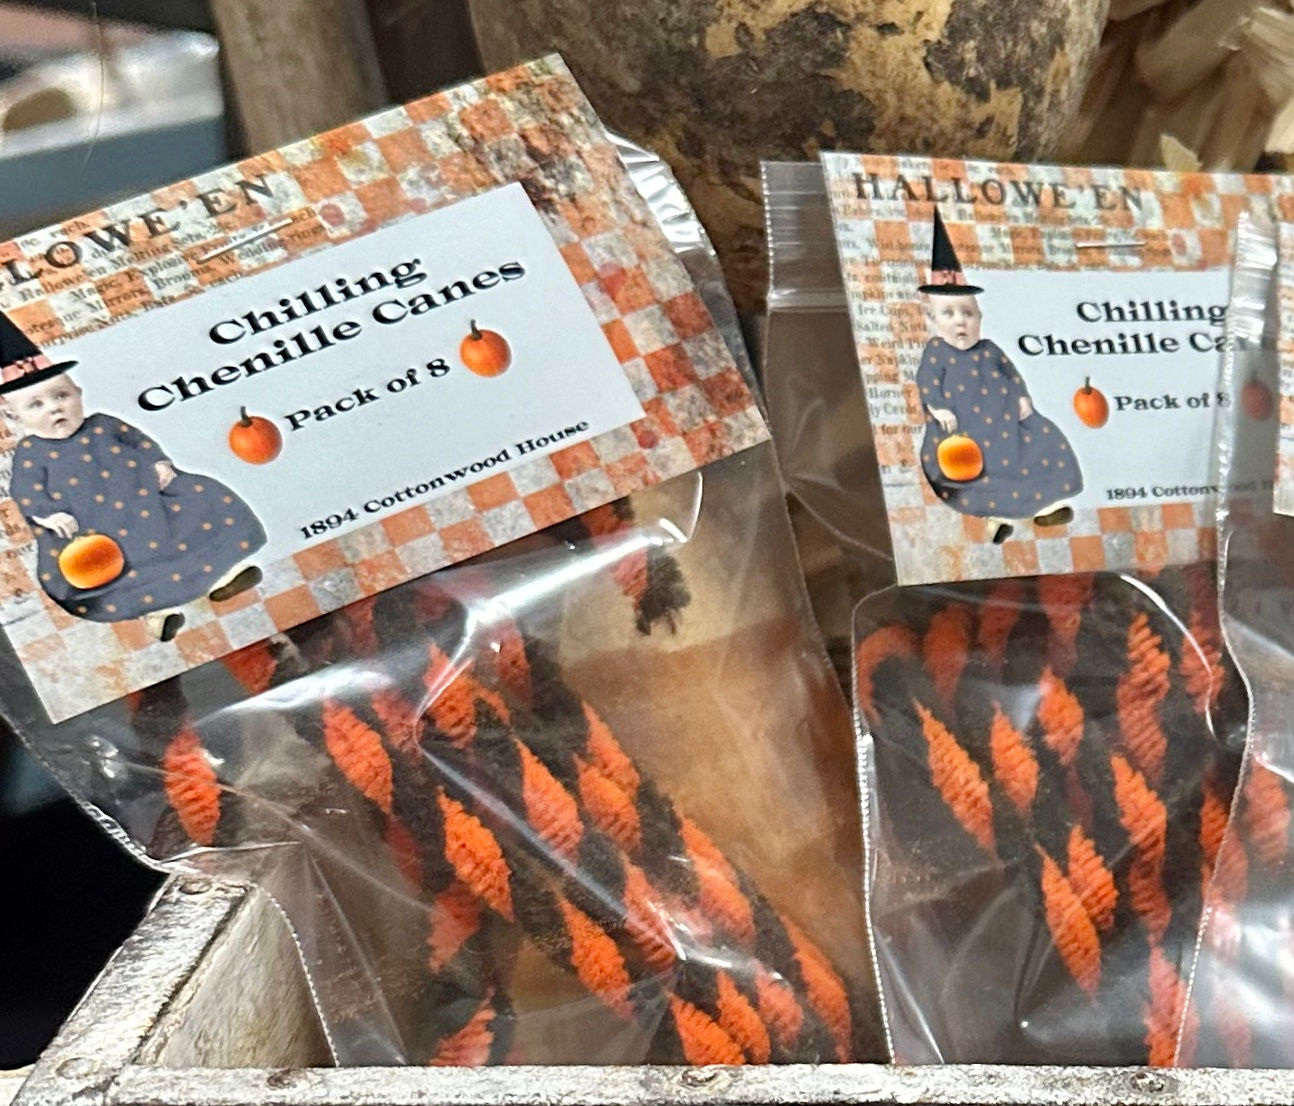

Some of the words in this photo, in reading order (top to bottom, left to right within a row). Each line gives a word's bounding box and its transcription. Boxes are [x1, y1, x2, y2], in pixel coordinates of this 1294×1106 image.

[853, 171, 1146, 212] HALLOWE'EN
[0, 174, 274, 288] LOWE'EN
[209, 257, 428, 345] Chilling
[1077, 299, 1228, 327] Chilling
[138, 320, 362, 412] Chenille
[372, 261, 526, 325] Canes
[1018, 331, 1180, 357] Chenille
[284, 387, 380, 432] Pack
[386, 368, 422, 394] of
[426, 358, 451, 378] 8
[1114, 392, 1181, 412] Pack
[1186, 392, 1211, 409] of
[299, 508, 360, 539] 1894
[363, 448, 512, 514] Cottonwood
[515, 420, 590, 456] House
[1106, 486, 1149, 500] 1894
